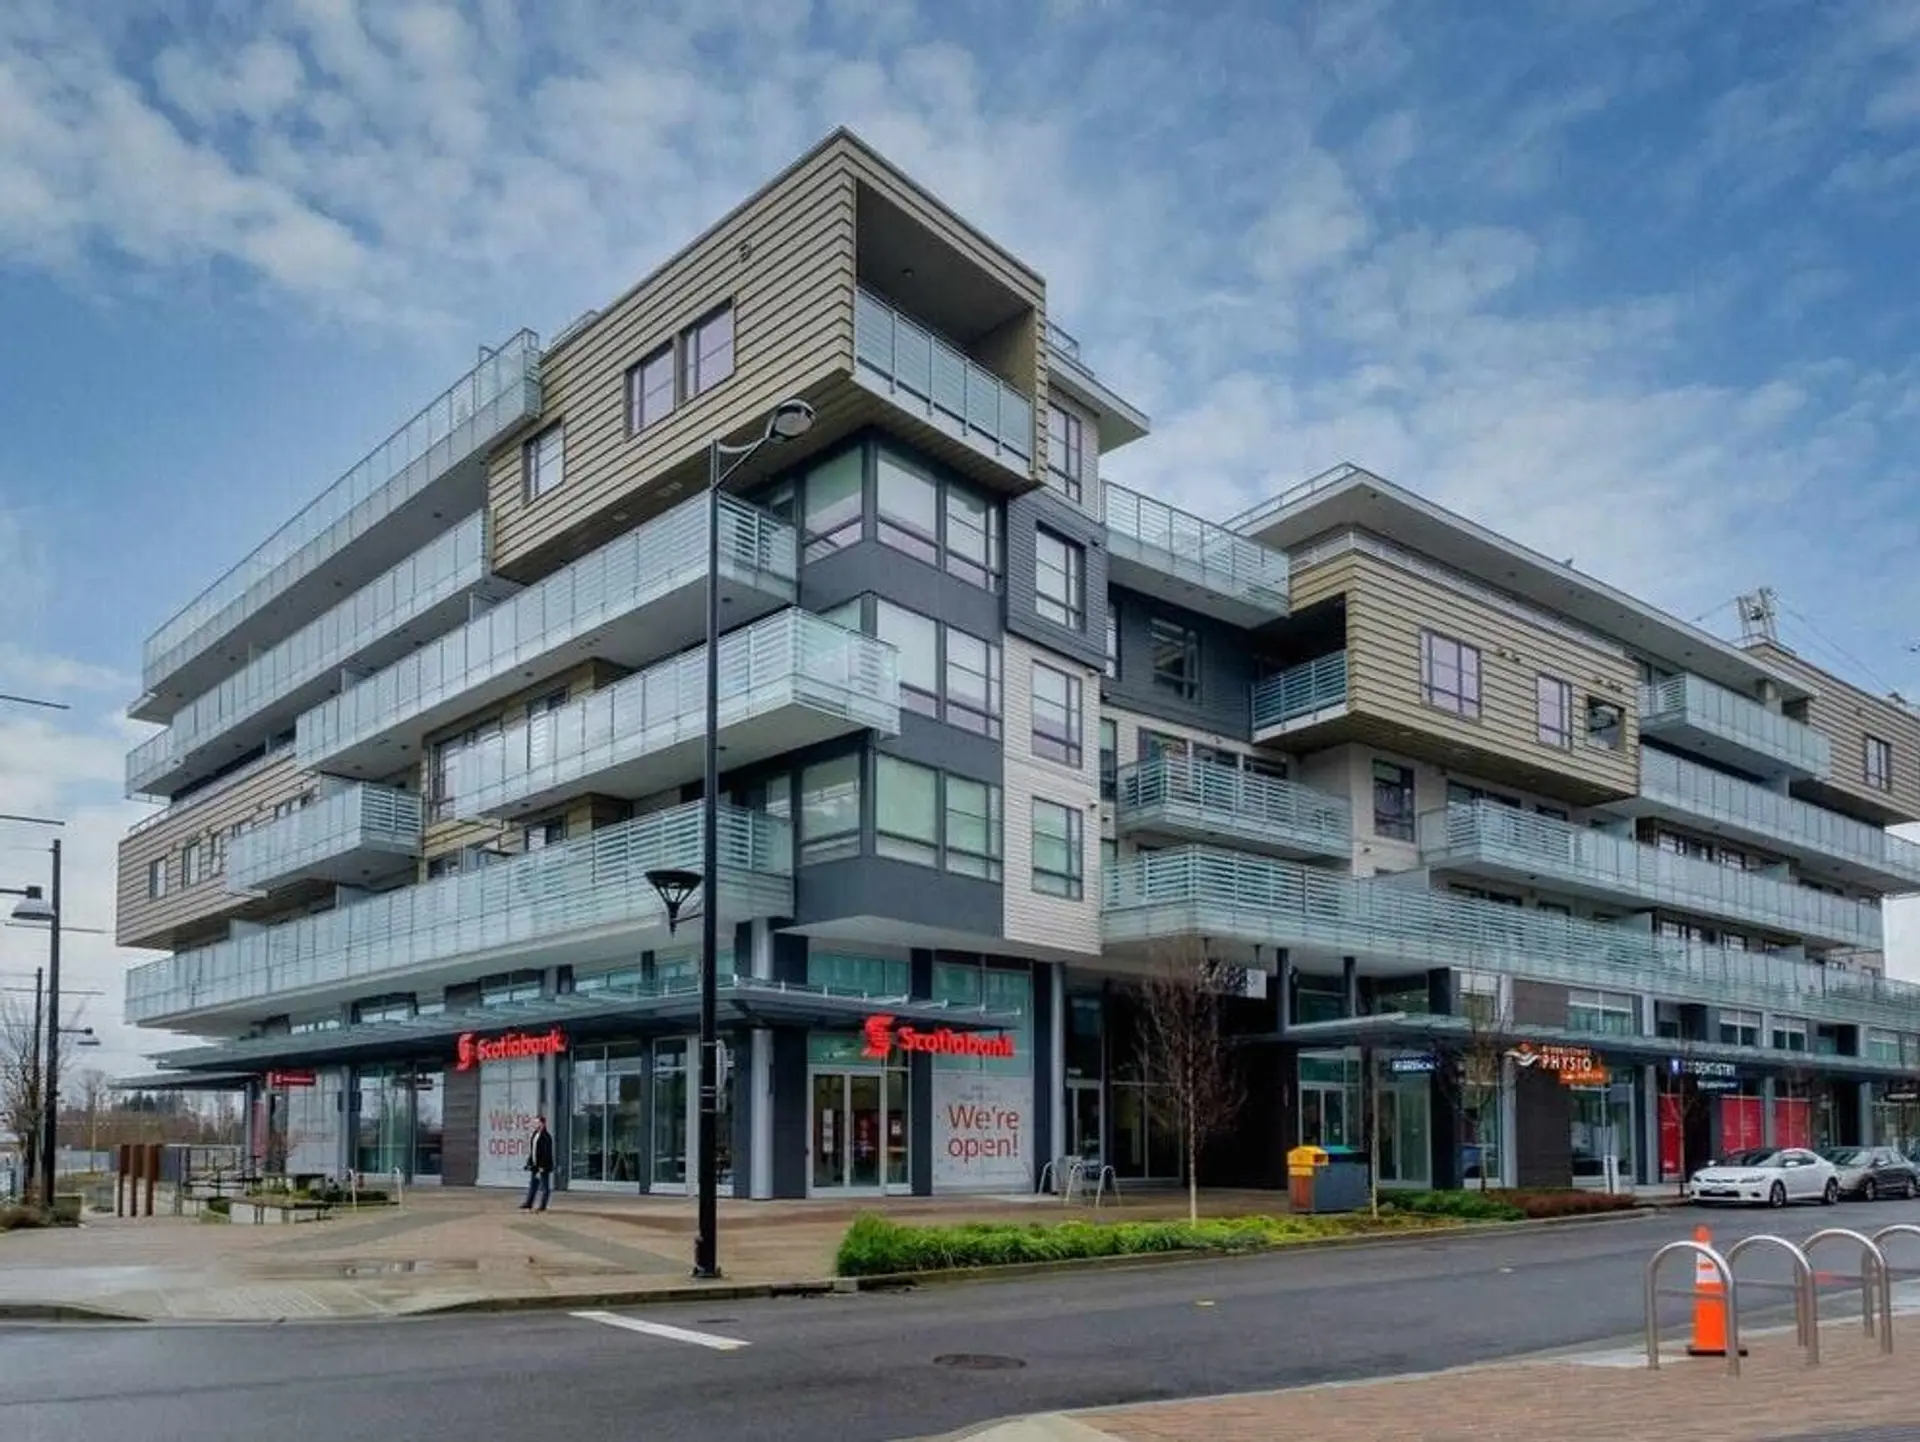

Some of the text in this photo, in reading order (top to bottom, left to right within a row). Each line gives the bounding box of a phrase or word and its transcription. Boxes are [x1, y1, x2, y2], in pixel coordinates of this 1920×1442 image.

[477, 1029, 566, 1061] Scotiabank
[897, 1026, 1015, 1058] Scotiabank
[1541, 1054, 1592, 1072] PHYSIO
[947, 1103, 1020, 1130] We're
[947, 1132, 1018, 1164] open!
